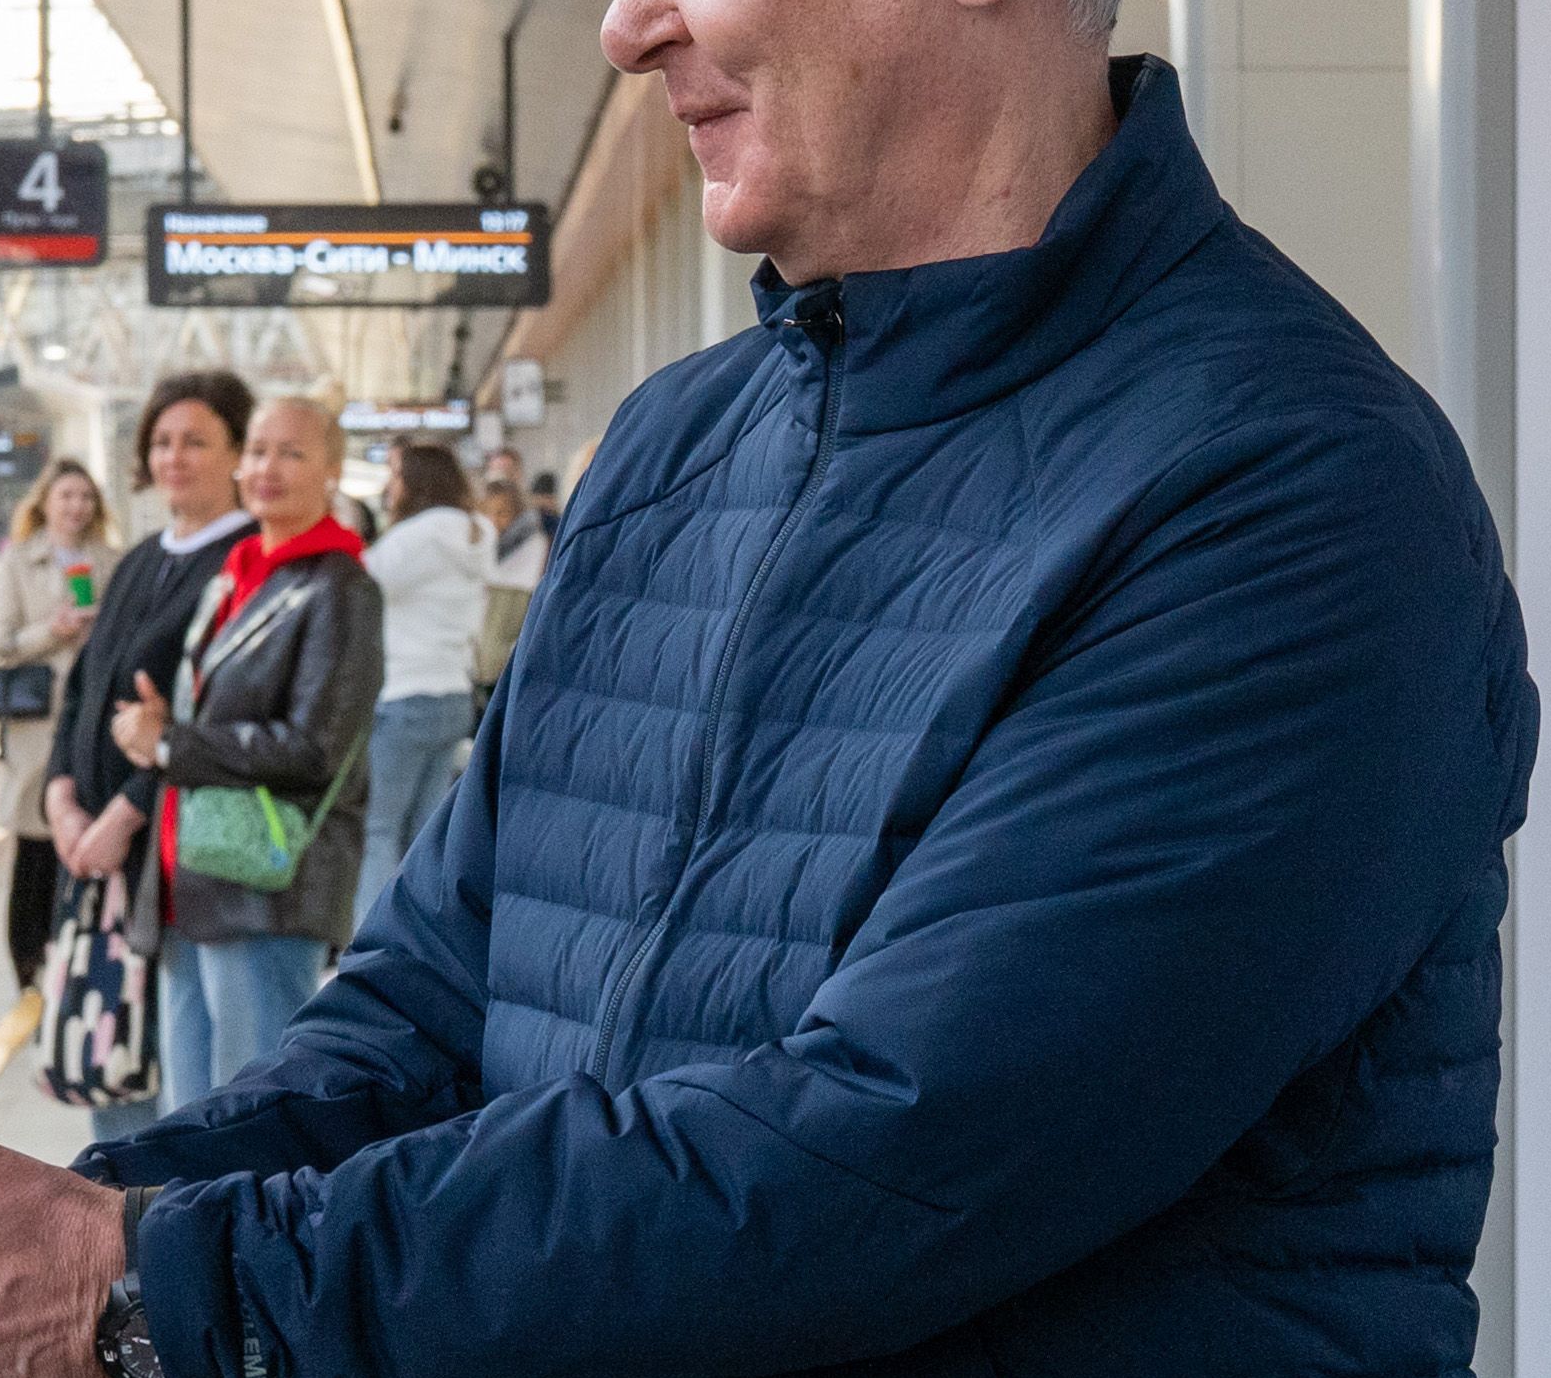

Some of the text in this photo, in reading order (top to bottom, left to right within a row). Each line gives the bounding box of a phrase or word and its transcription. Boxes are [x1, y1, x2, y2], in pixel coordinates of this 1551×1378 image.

[17, 151, 65, 213] 4
[165, 239, 389, 274] Москва-Сити
[412, 239, 529, 273] Минск
